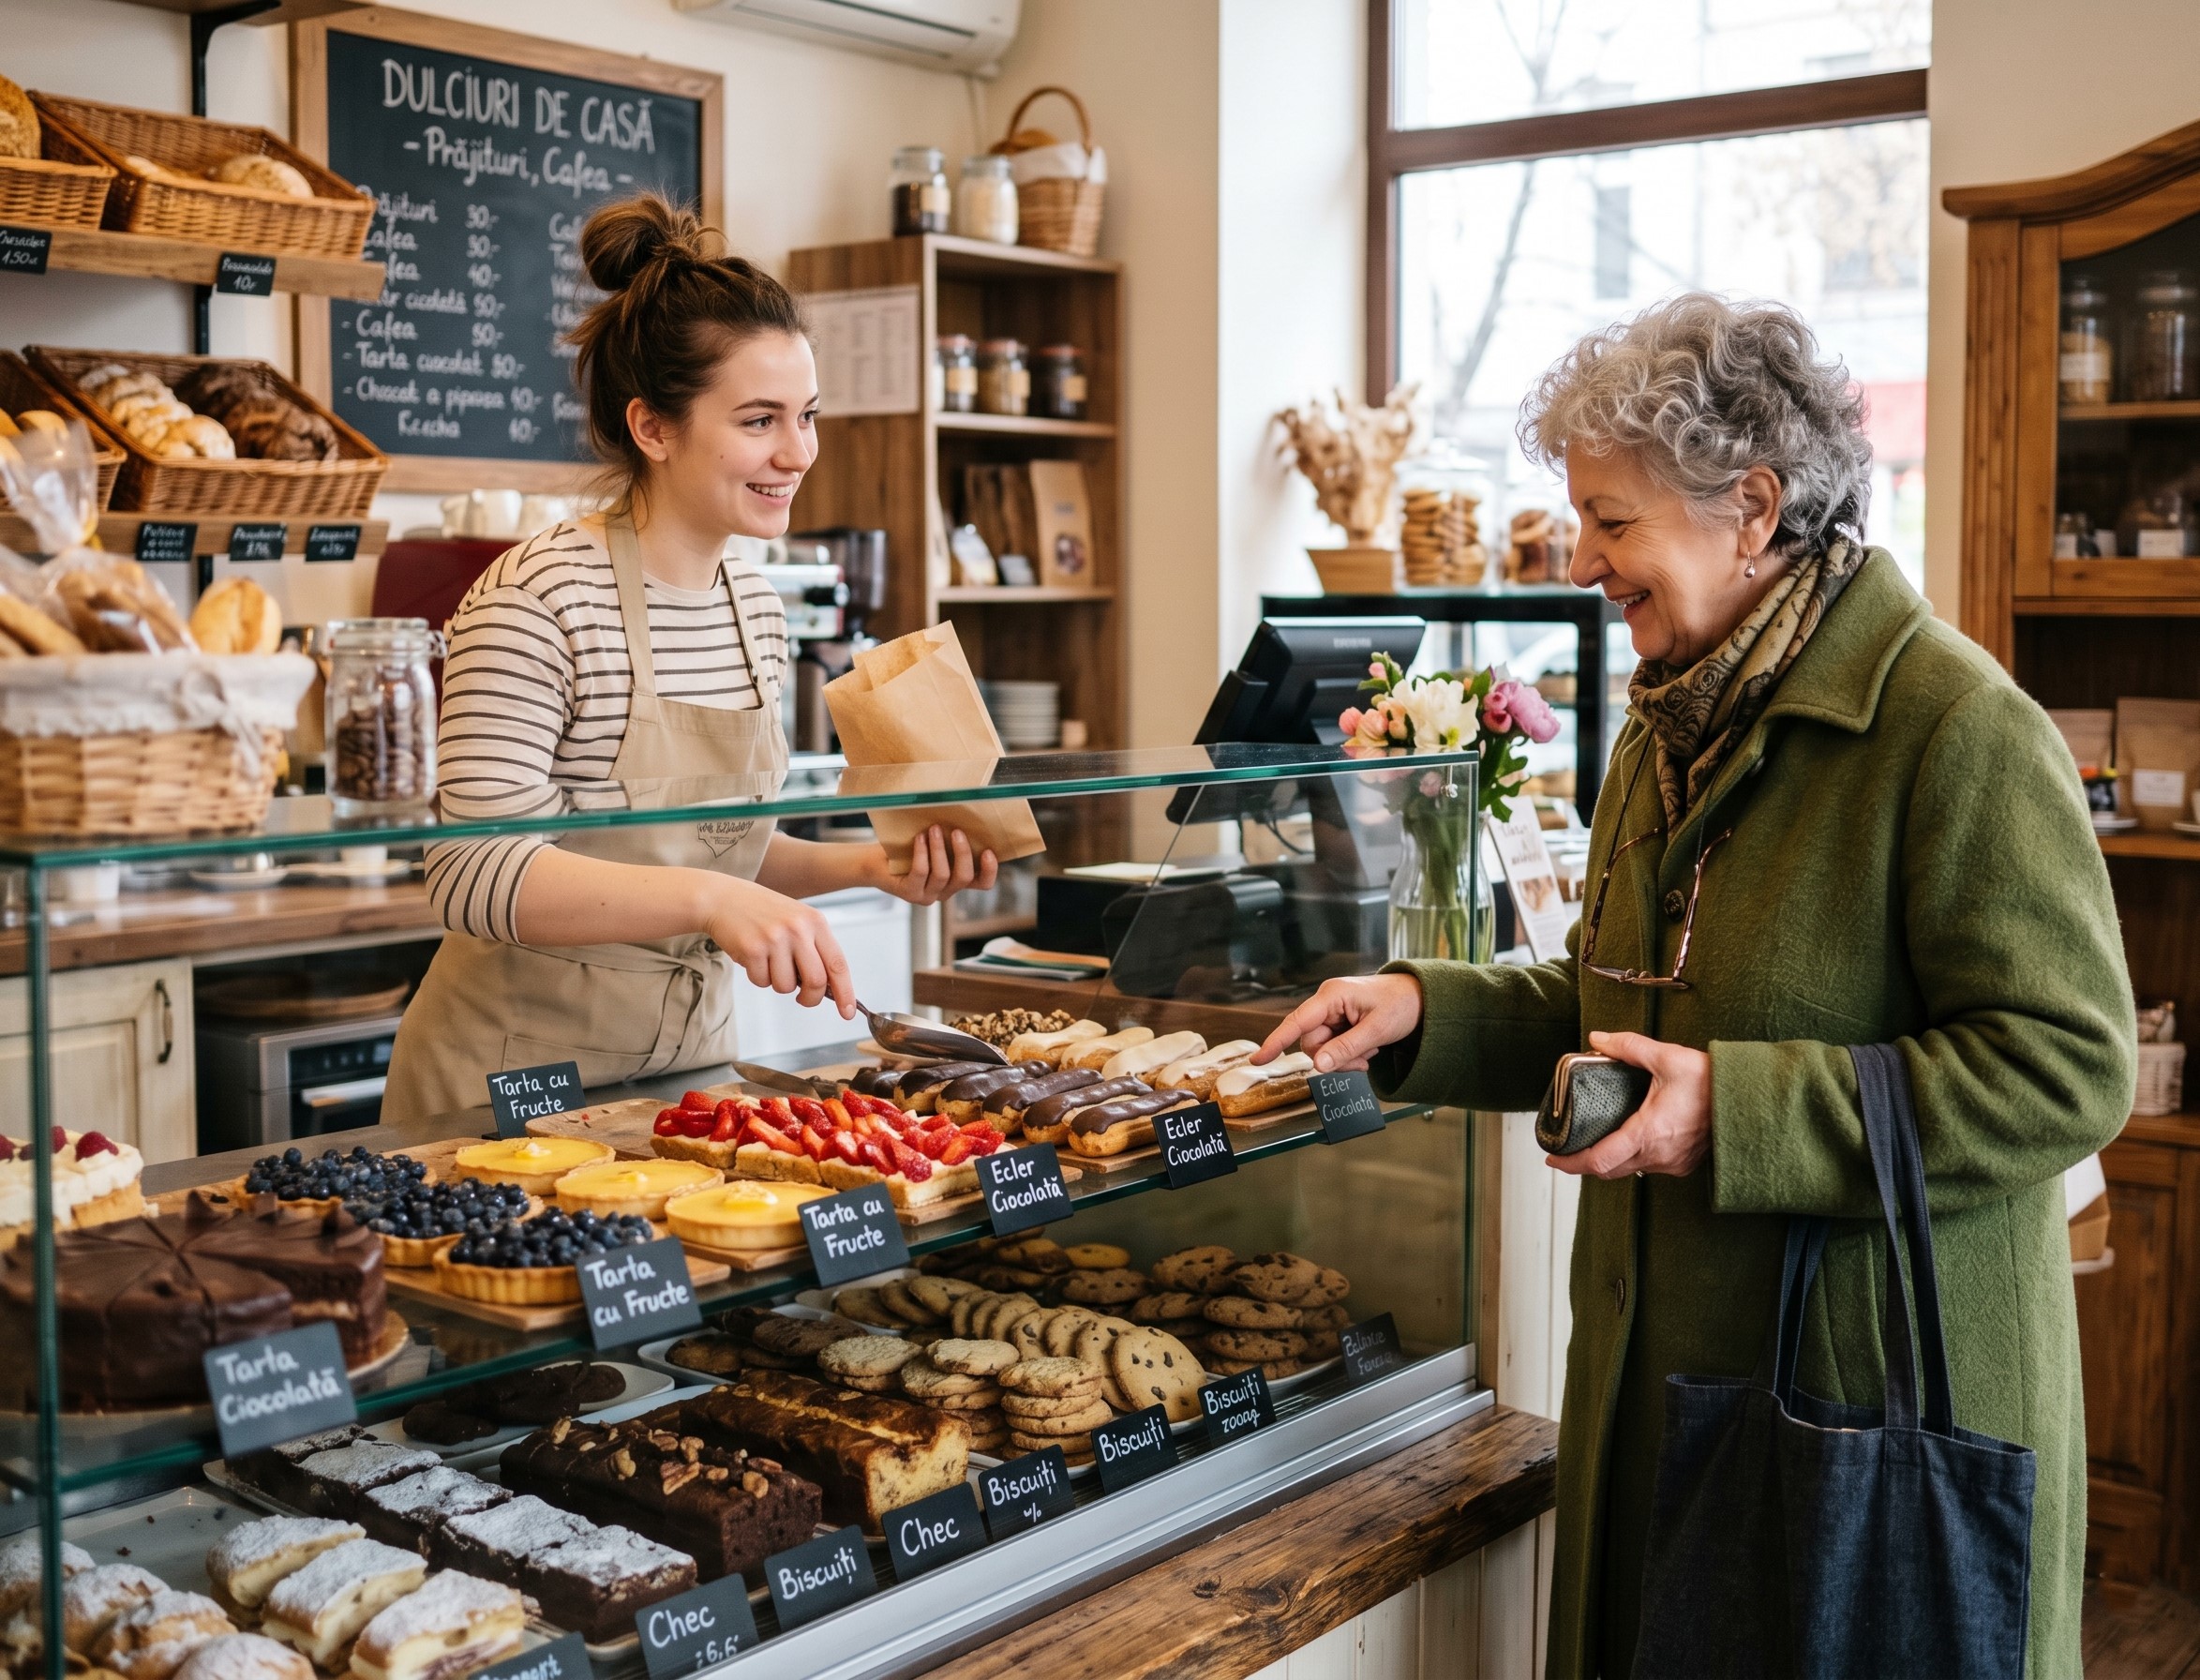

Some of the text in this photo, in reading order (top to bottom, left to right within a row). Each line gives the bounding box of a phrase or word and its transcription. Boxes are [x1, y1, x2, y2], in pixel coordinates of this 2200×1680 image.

[382, 58, 656, 155] DULCIURI DE CASĂ
[542, 145, 614, 200] Cafea
[364, 218, 419, 254] afea
[356, 308, 419, 346] Cafea
[355, 341, 412, 371] Tarta
[492, 1073, 569, 1096] Tarta cu
[1320, 1077, 1351, 1097] Ecler
[510, 1095, 564, 1118] Fructe
[1164, 1117, 1203, 1140] Ecler
[1167, 1132, 1228, 1166] Ciocolată
[990, 1157, 1035, 1185] Ecler
[991, 1176, 1064, 1213] Ciocolată
[803, 1198, 885, 1230] Tarta cu
[823, 1223, 886, 1258] Fructe
[584, 1253, 656, 1290] Tarta
[593, 1280, 690, 1328] cu Fructe
[218, 1366, 343, 1425] Ciocolată
[1205, 1373, 1261, 1416] Biscuiți
[1098, 1416, 1166, 1463] Biscuiți
[987, 1459, 1057, 1507] Biscuiți
[900, 1517, 961, 1557] Chec
[778, 1547, 859, 1601] Biscuiți
[649, 1606, 715, 1648] Chec
